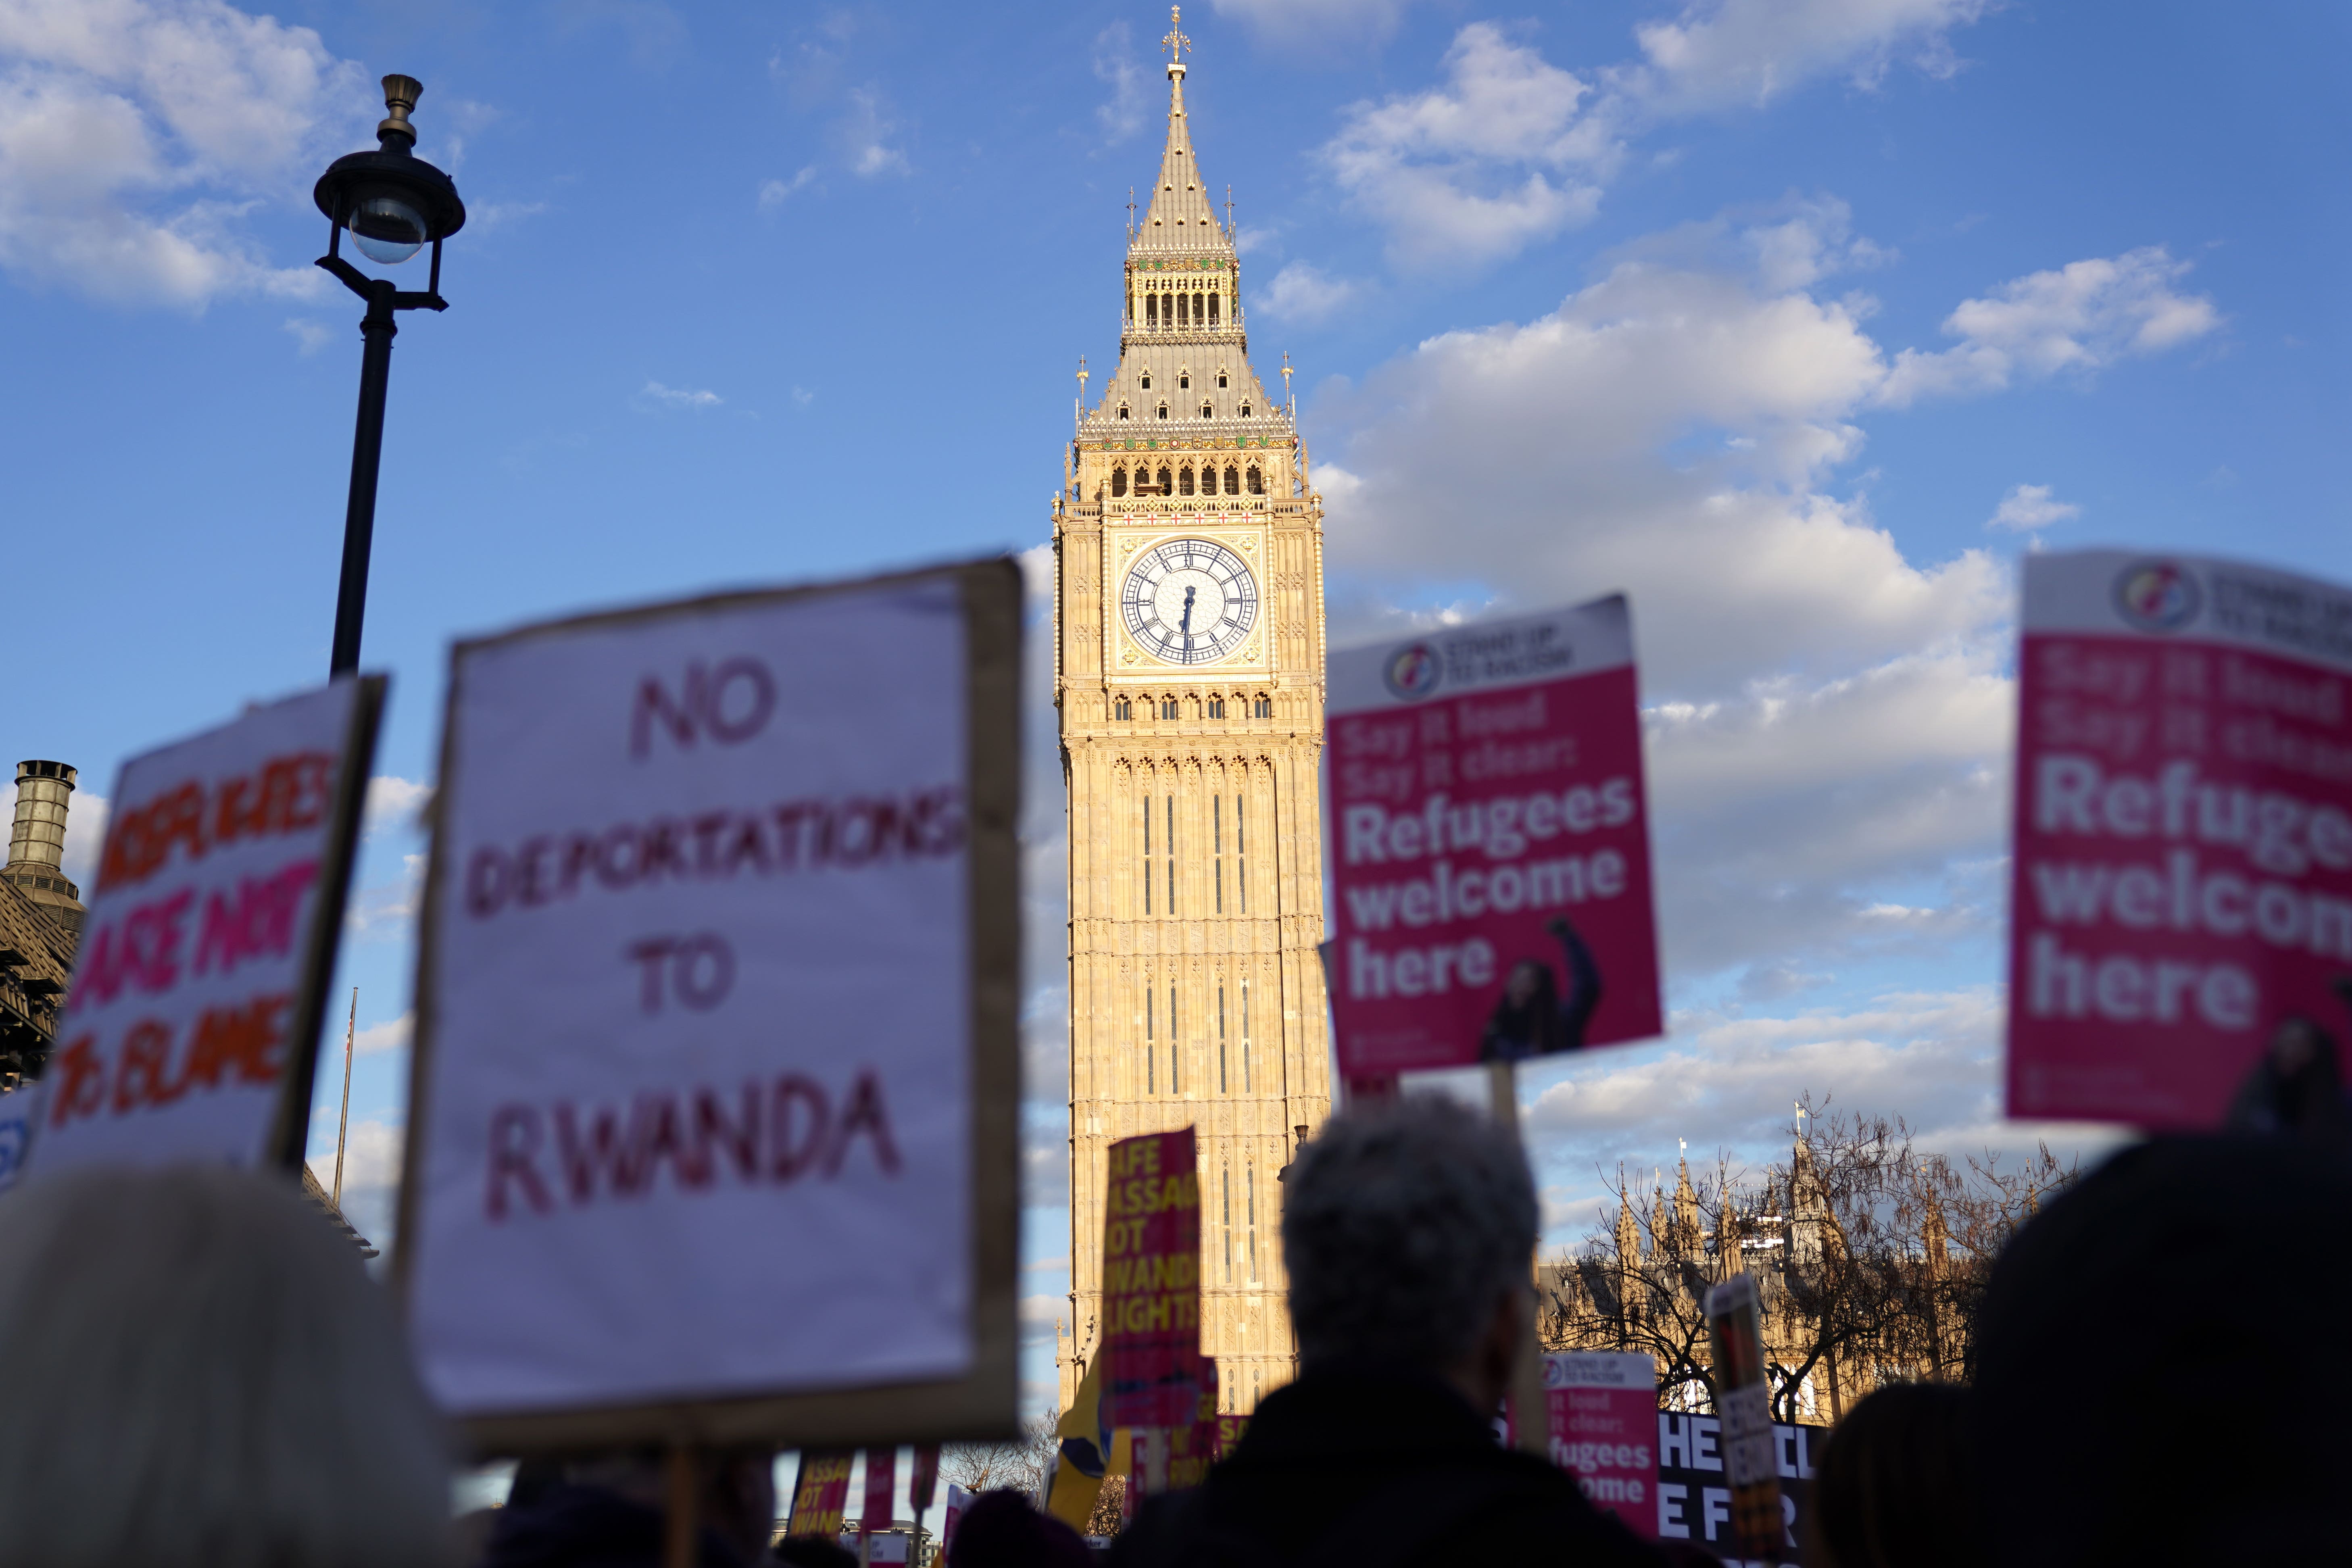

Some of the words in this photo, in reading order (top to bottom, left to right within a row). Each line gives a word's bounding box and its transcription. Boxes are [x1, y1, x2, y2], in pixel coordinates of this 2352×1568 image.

[630, 654, 778, 761] NO
[463, 783, 969, 920] DEPORTATIONS
[1344, 778, 1635, 864] Refugees
[1346, 848, 1626, 930] welcome
[624, 931, 736, 1012] TO
[1347, 937, 1495, 1000] here
[2029, 930, 2257, 1032] here
[483, 1065, 905, 1226] RWANDA
[1548, 1436, 1651, 1474] fugees
[1659, 1414, 1722, 1472] HE
